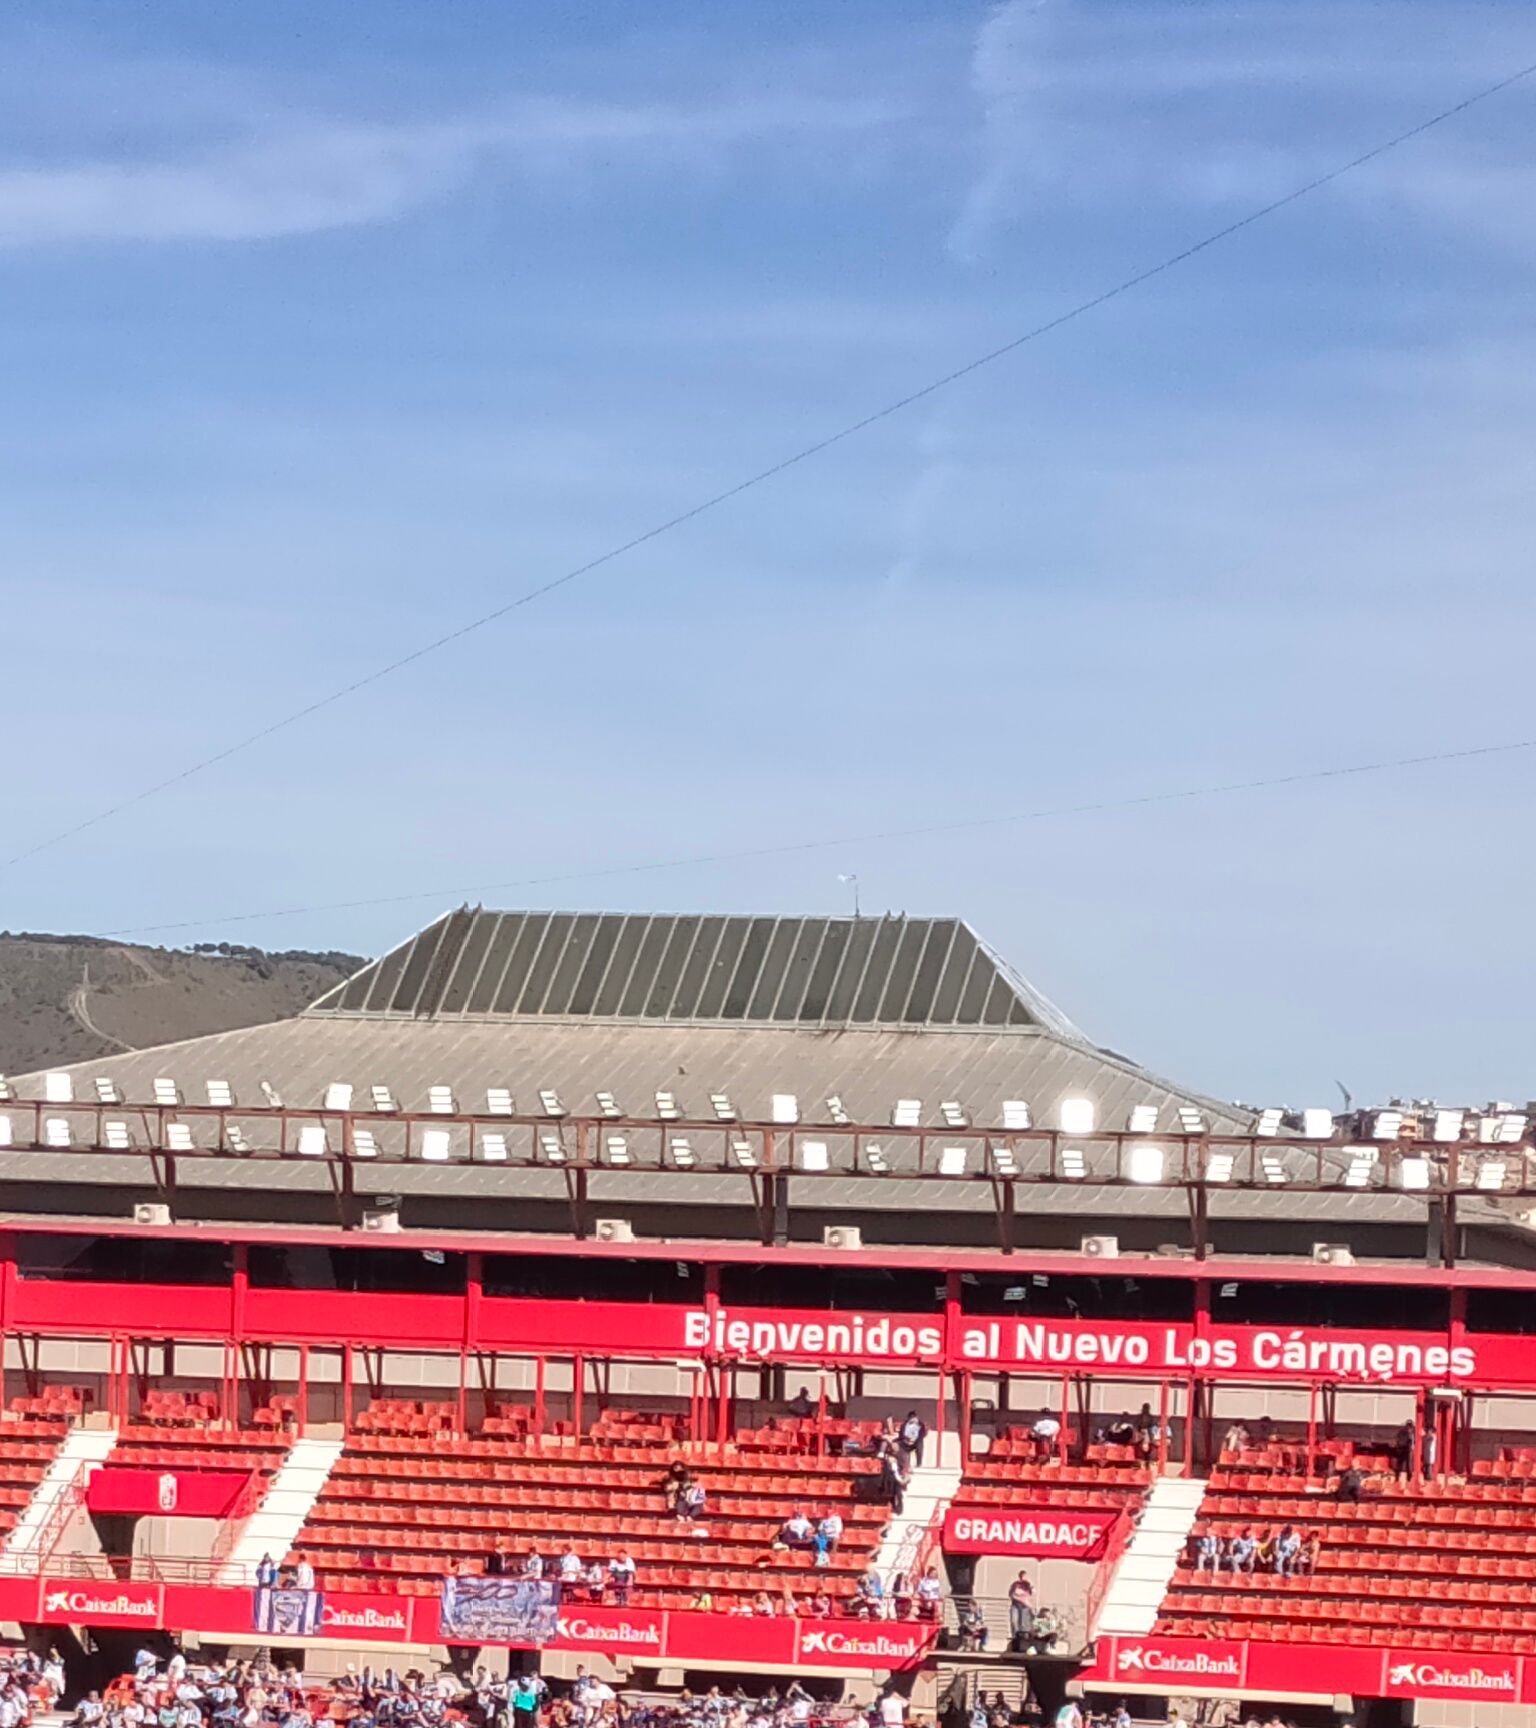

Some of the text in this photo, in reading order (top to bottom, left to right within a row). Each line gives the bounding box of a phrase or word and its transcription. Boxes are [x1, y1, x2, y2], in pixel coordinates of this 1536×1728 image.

[684, 1311, 1476, 1376] Bienvenidos al Nuevo Los Cármenes
[70, 1592, 157, 1616] CaixaBank
[570, 1619, 660, 1644] CaixaBank
[827, 1634, 918, 1658] CaixaBank
[1144, 1650, 1240, 1675] CaixaBank
[1416, 1665, 1515, 1690] CaixaBank
